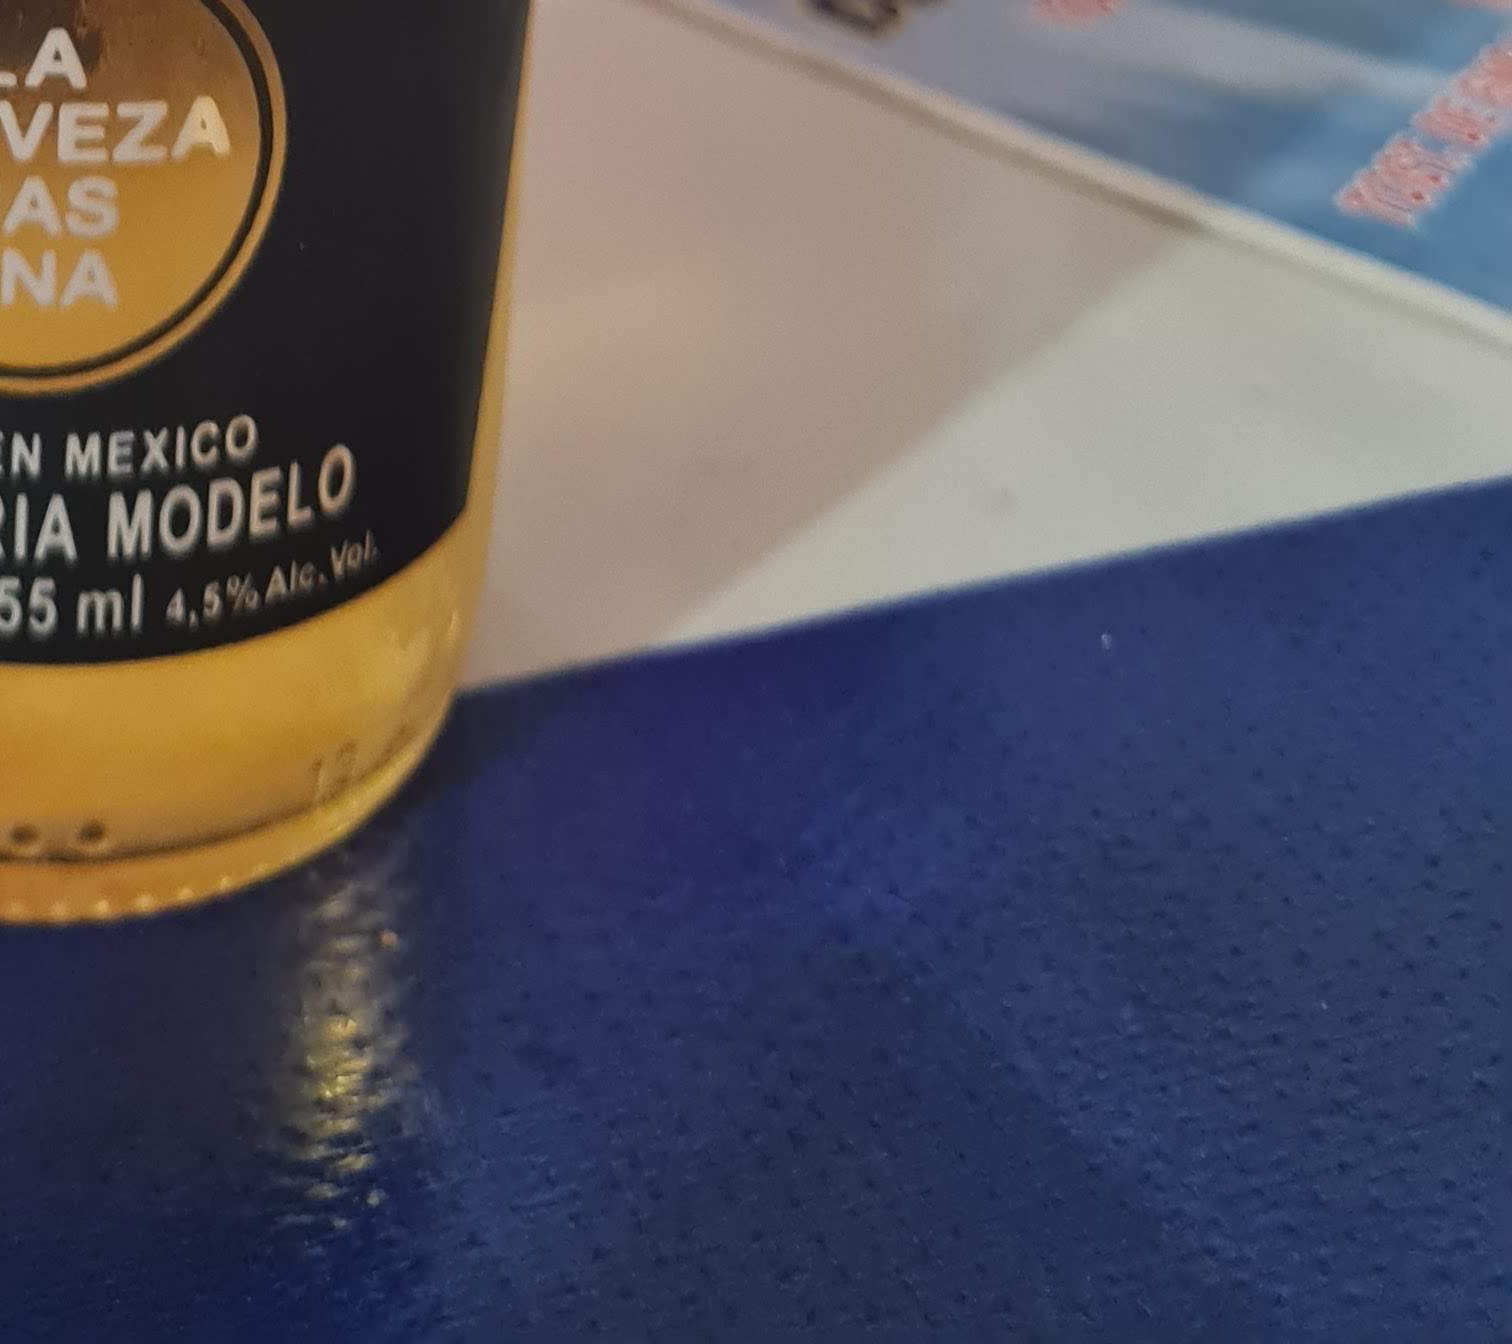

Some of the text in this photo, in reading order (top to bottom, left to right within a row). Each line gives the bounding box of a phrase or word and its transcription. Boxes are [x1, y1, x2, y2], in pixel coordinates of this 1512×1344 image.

[64, 412, 260, 481] MEXICO
[106, 442, 358, 564] MODELO
[75, 572, 146, 638] ml
